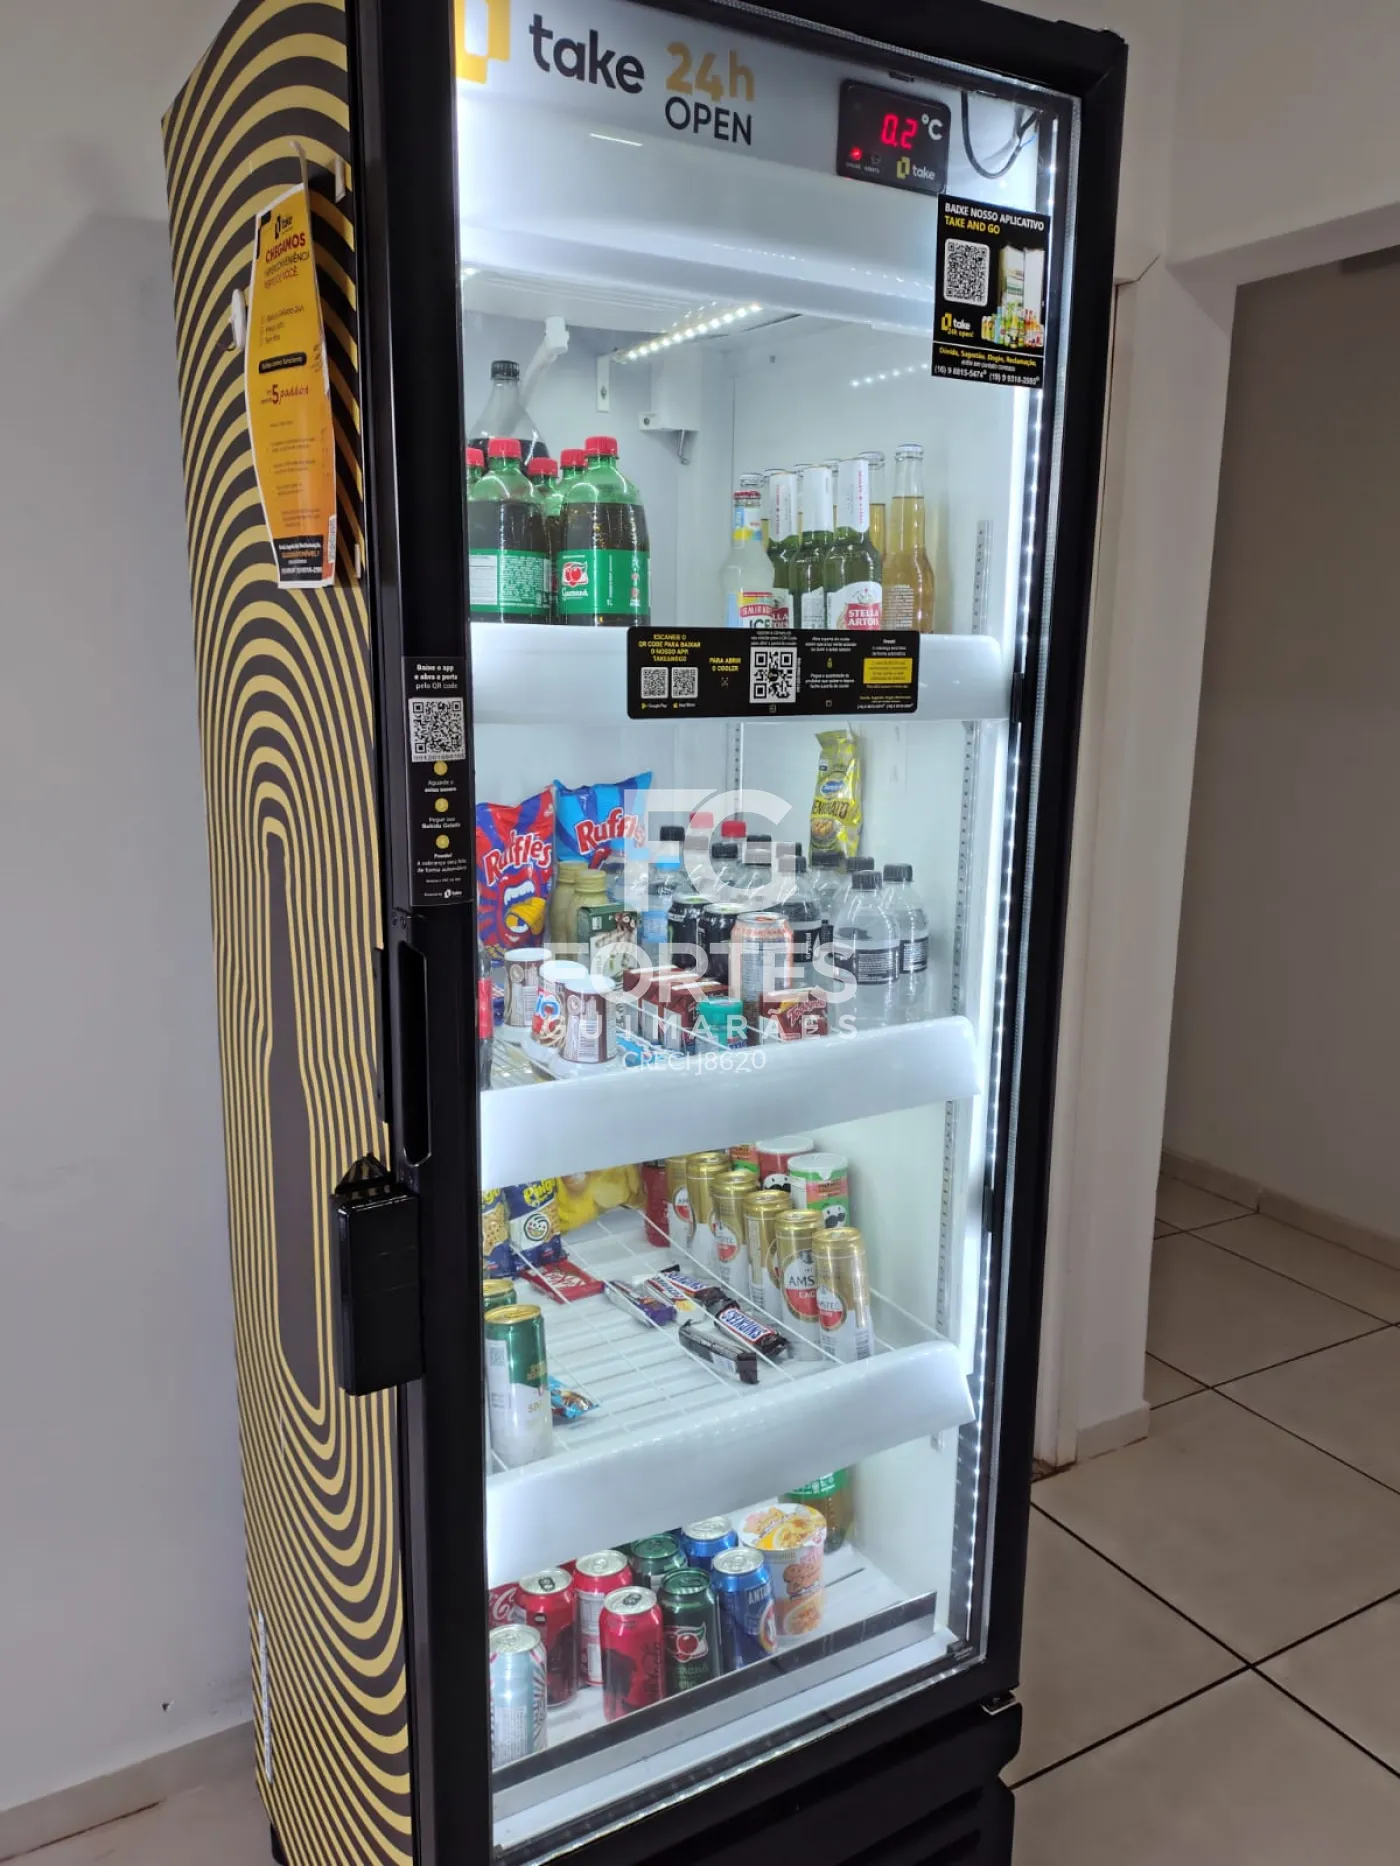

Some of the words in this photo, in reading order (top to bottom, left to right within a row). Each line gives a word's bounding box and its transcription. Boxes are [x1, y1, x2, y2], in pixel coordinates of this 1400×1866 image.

[529, 14, 645, 94] take
[666, 41, 755, 102] 24h
[665, 96, 752, 146] OPEN
[912, 164, 936, 180] take
[944, 203, 969, 217] BAIXE
[970, 206, 998, 221] NOSSO
[1000, 212, 1045, 231] APLICATIVO
[944, 215, 966, 228] TAKE
[966, 220, 986, 232] AND
[987, 222, 1001, 234] GO
[952, 318, 972, 330] take
[847, 617, 880, 627] ARTOIS
[848, 610, 881, 618] STELLA
[415, 682, 431, 690] pelo
[483, 828, 553, 887] Ruffles
